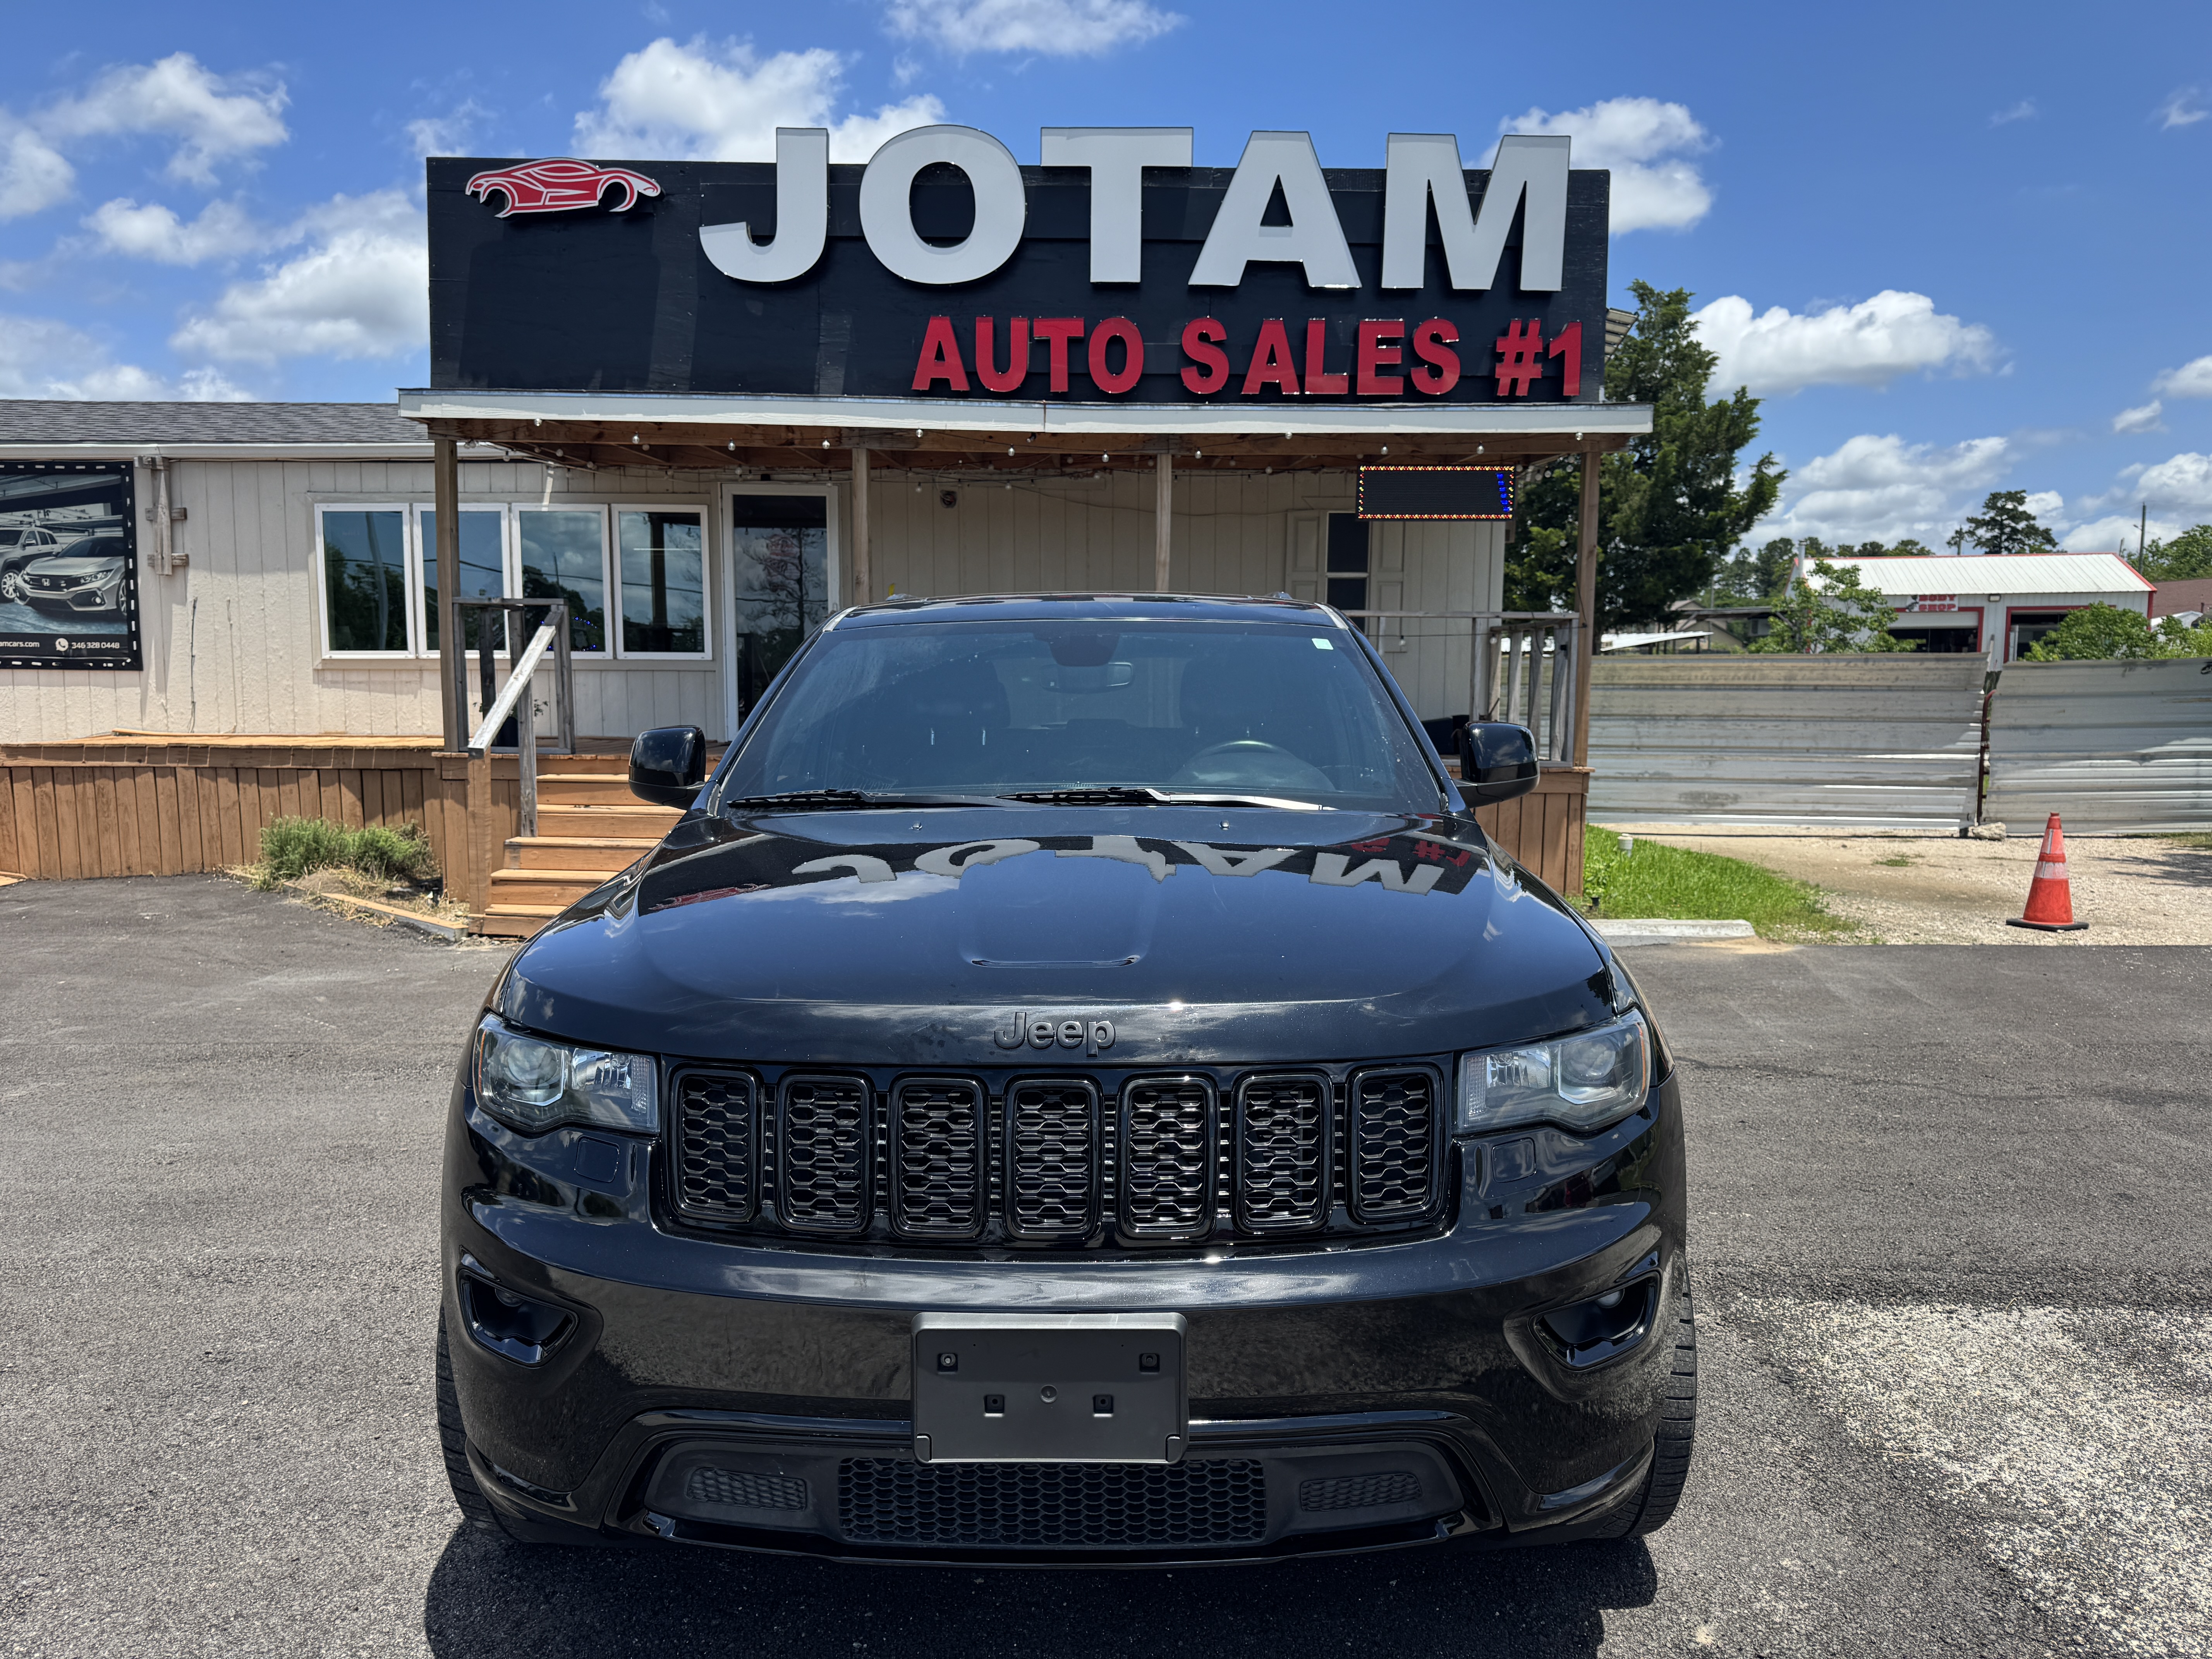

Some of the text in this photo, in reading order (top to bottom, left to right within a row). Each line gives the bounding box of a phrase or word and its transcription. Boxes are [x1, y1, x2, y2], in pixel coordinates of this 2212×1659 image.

[699, 125, 1571, 292] JOTAM
[912, 316, 1582, 396] AUTO SALES #1
[994, 1012, 1116, 1057] Jeep
